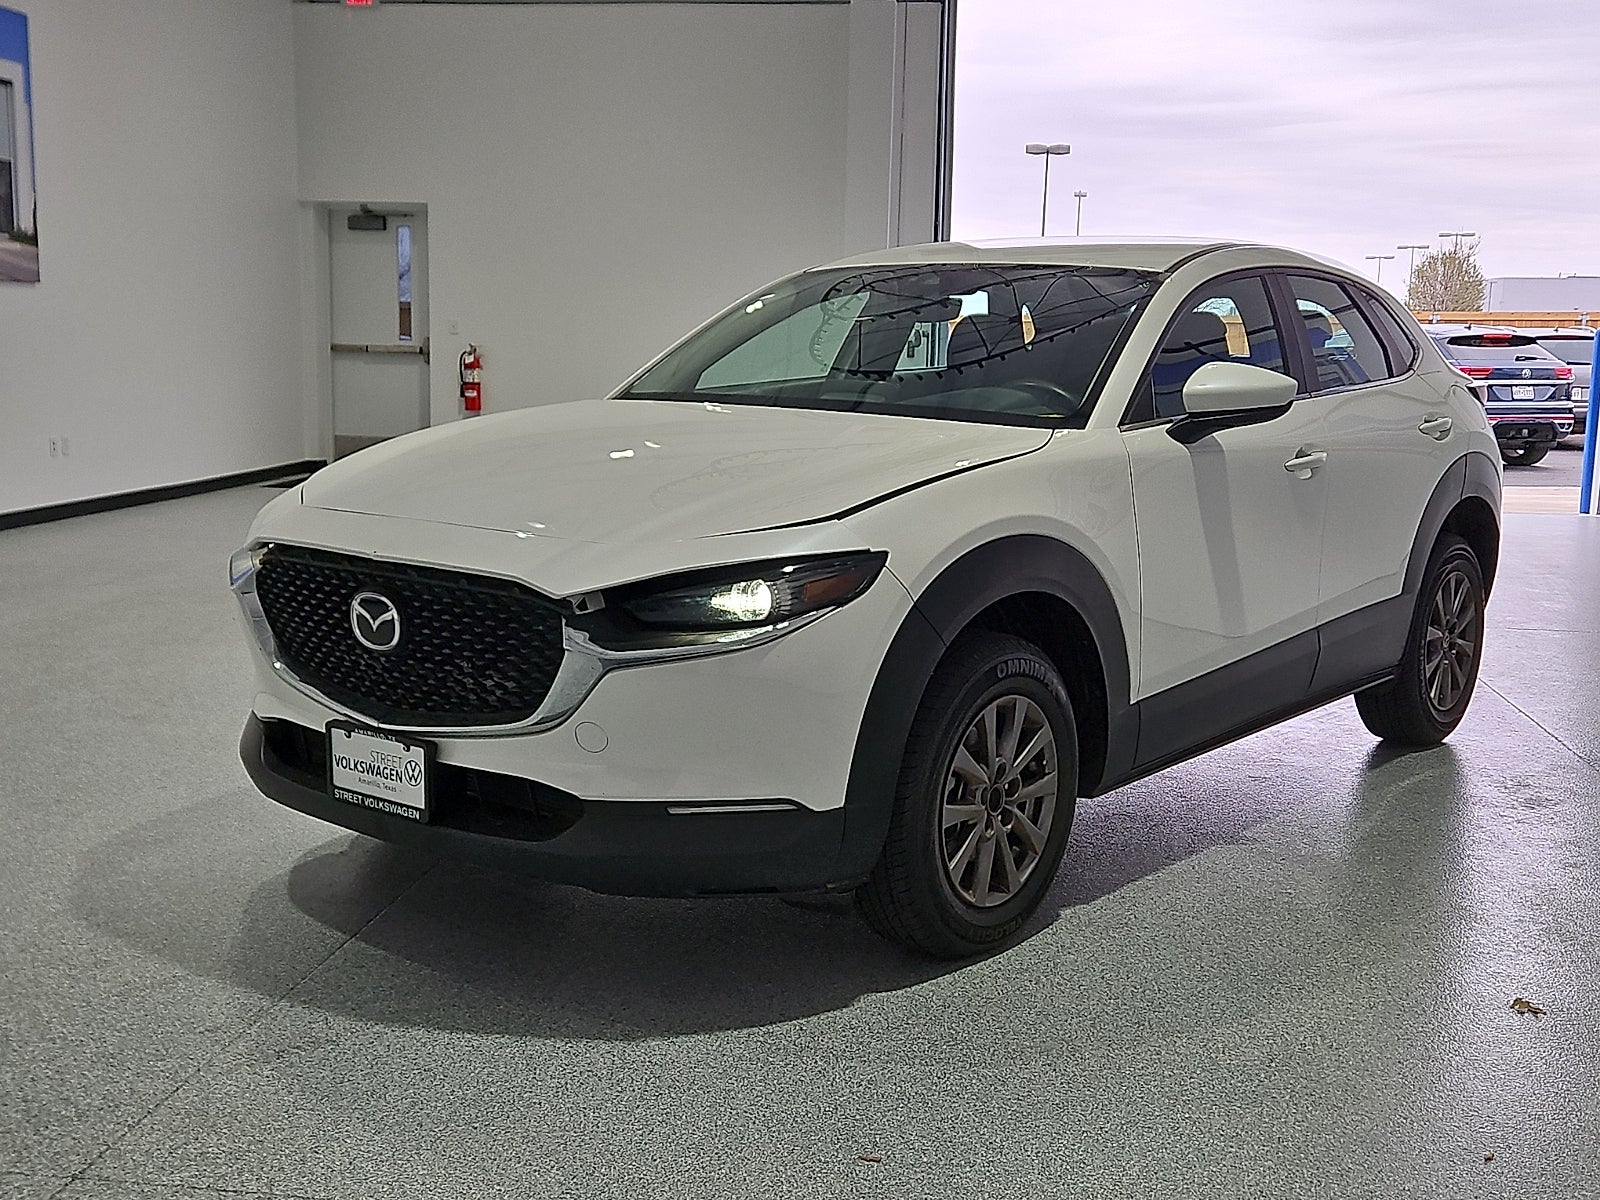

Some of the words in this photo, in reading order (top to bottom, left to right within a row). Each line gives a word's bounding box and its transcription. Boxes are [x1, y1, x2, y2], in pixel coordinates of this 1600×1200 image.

[333, 754, 403, 783] VOLKSWAGEN
[370, 750, 402, 768] STREET
[334, 789, 362, 804] STREET
[364, 797, 420, 820] VOLKSWAGEN
